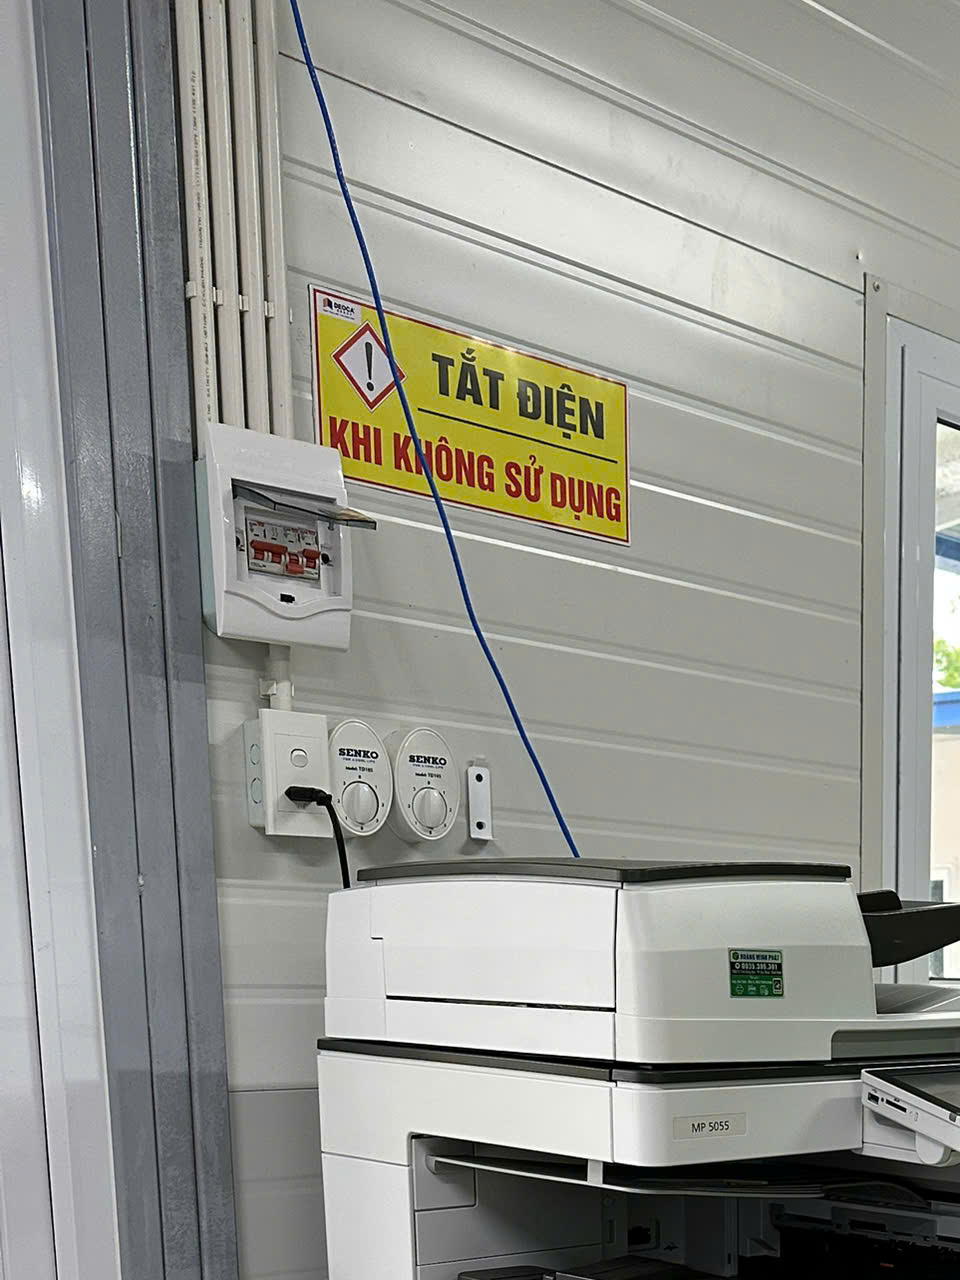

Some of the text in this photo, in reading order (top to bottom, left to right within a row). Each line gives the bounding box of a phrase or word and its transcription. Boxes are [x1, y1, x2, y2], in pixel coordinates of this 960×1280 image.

[431, 347, 605, 440] TẮT ĐIỆN
[328, 415, 622, 523] KHI KHÔNG SỬ DỤNG
[338, 747, 379, 760] SENKO
[408, 754, 447, 766] SENKO
[691, 1120, 730, 1133] MP 5055
